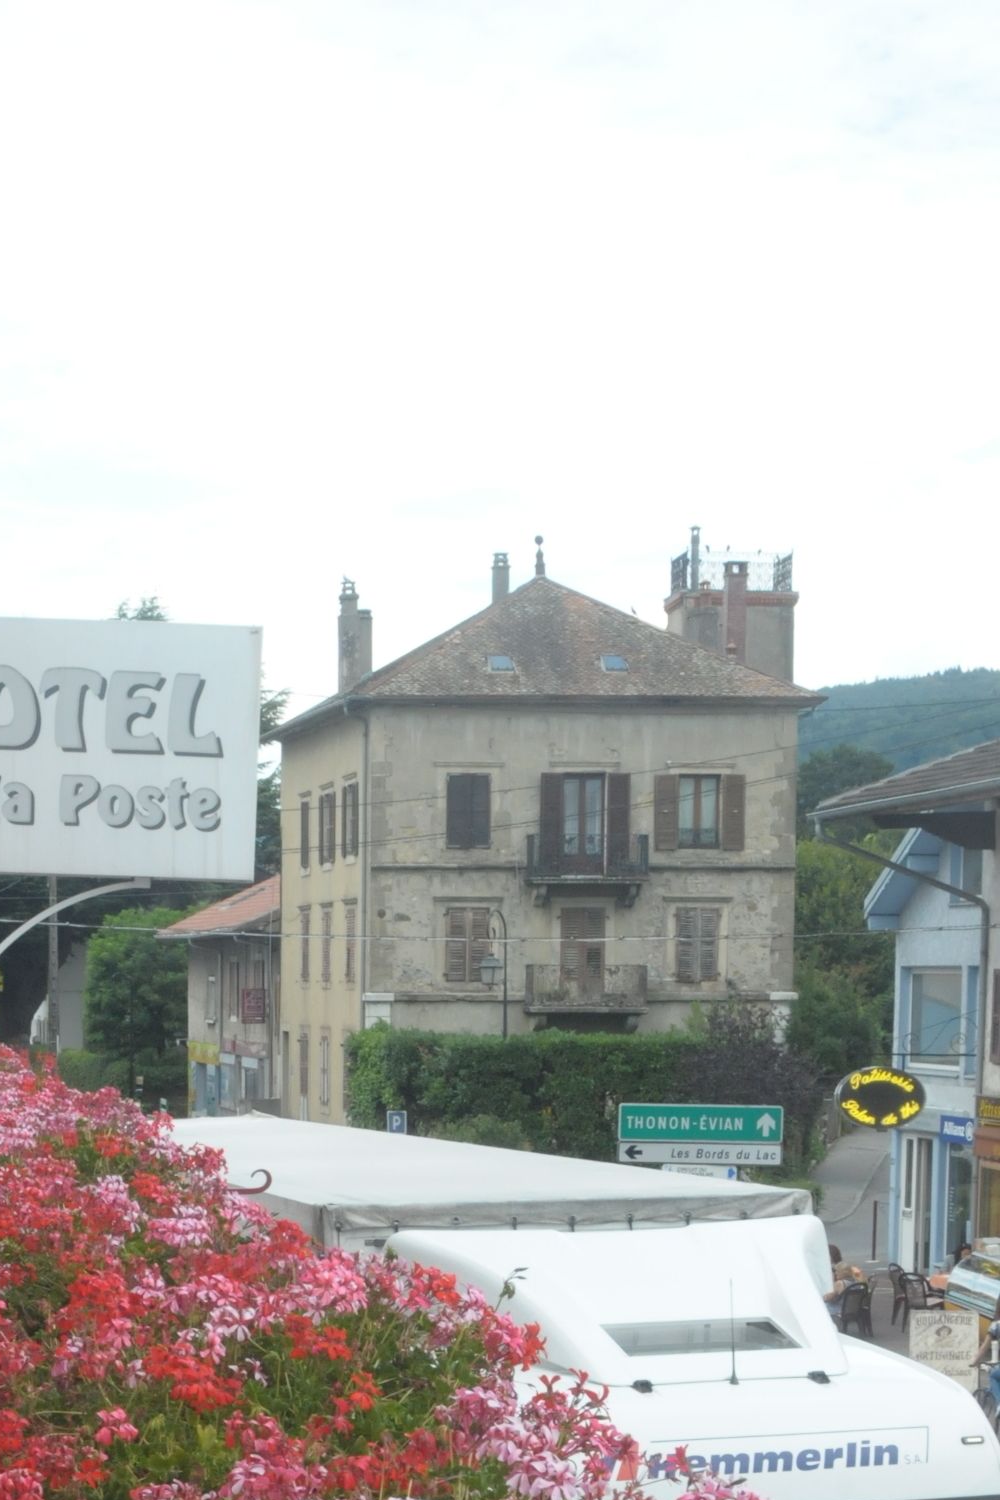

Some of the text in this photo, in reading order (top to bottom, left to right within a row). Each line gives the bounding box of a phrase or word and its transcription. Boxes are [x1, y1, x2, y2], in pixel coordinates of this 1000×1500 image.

[59, 774, 222, 832] Poste
[392, 1115, 401, 1130] P
[626, 1114, 744, 1131] THONON-ÉVIAN
[943, 1121, 965, 1136] Allianz
[671, 1148, 777, 1161] Les Bords du Lac
